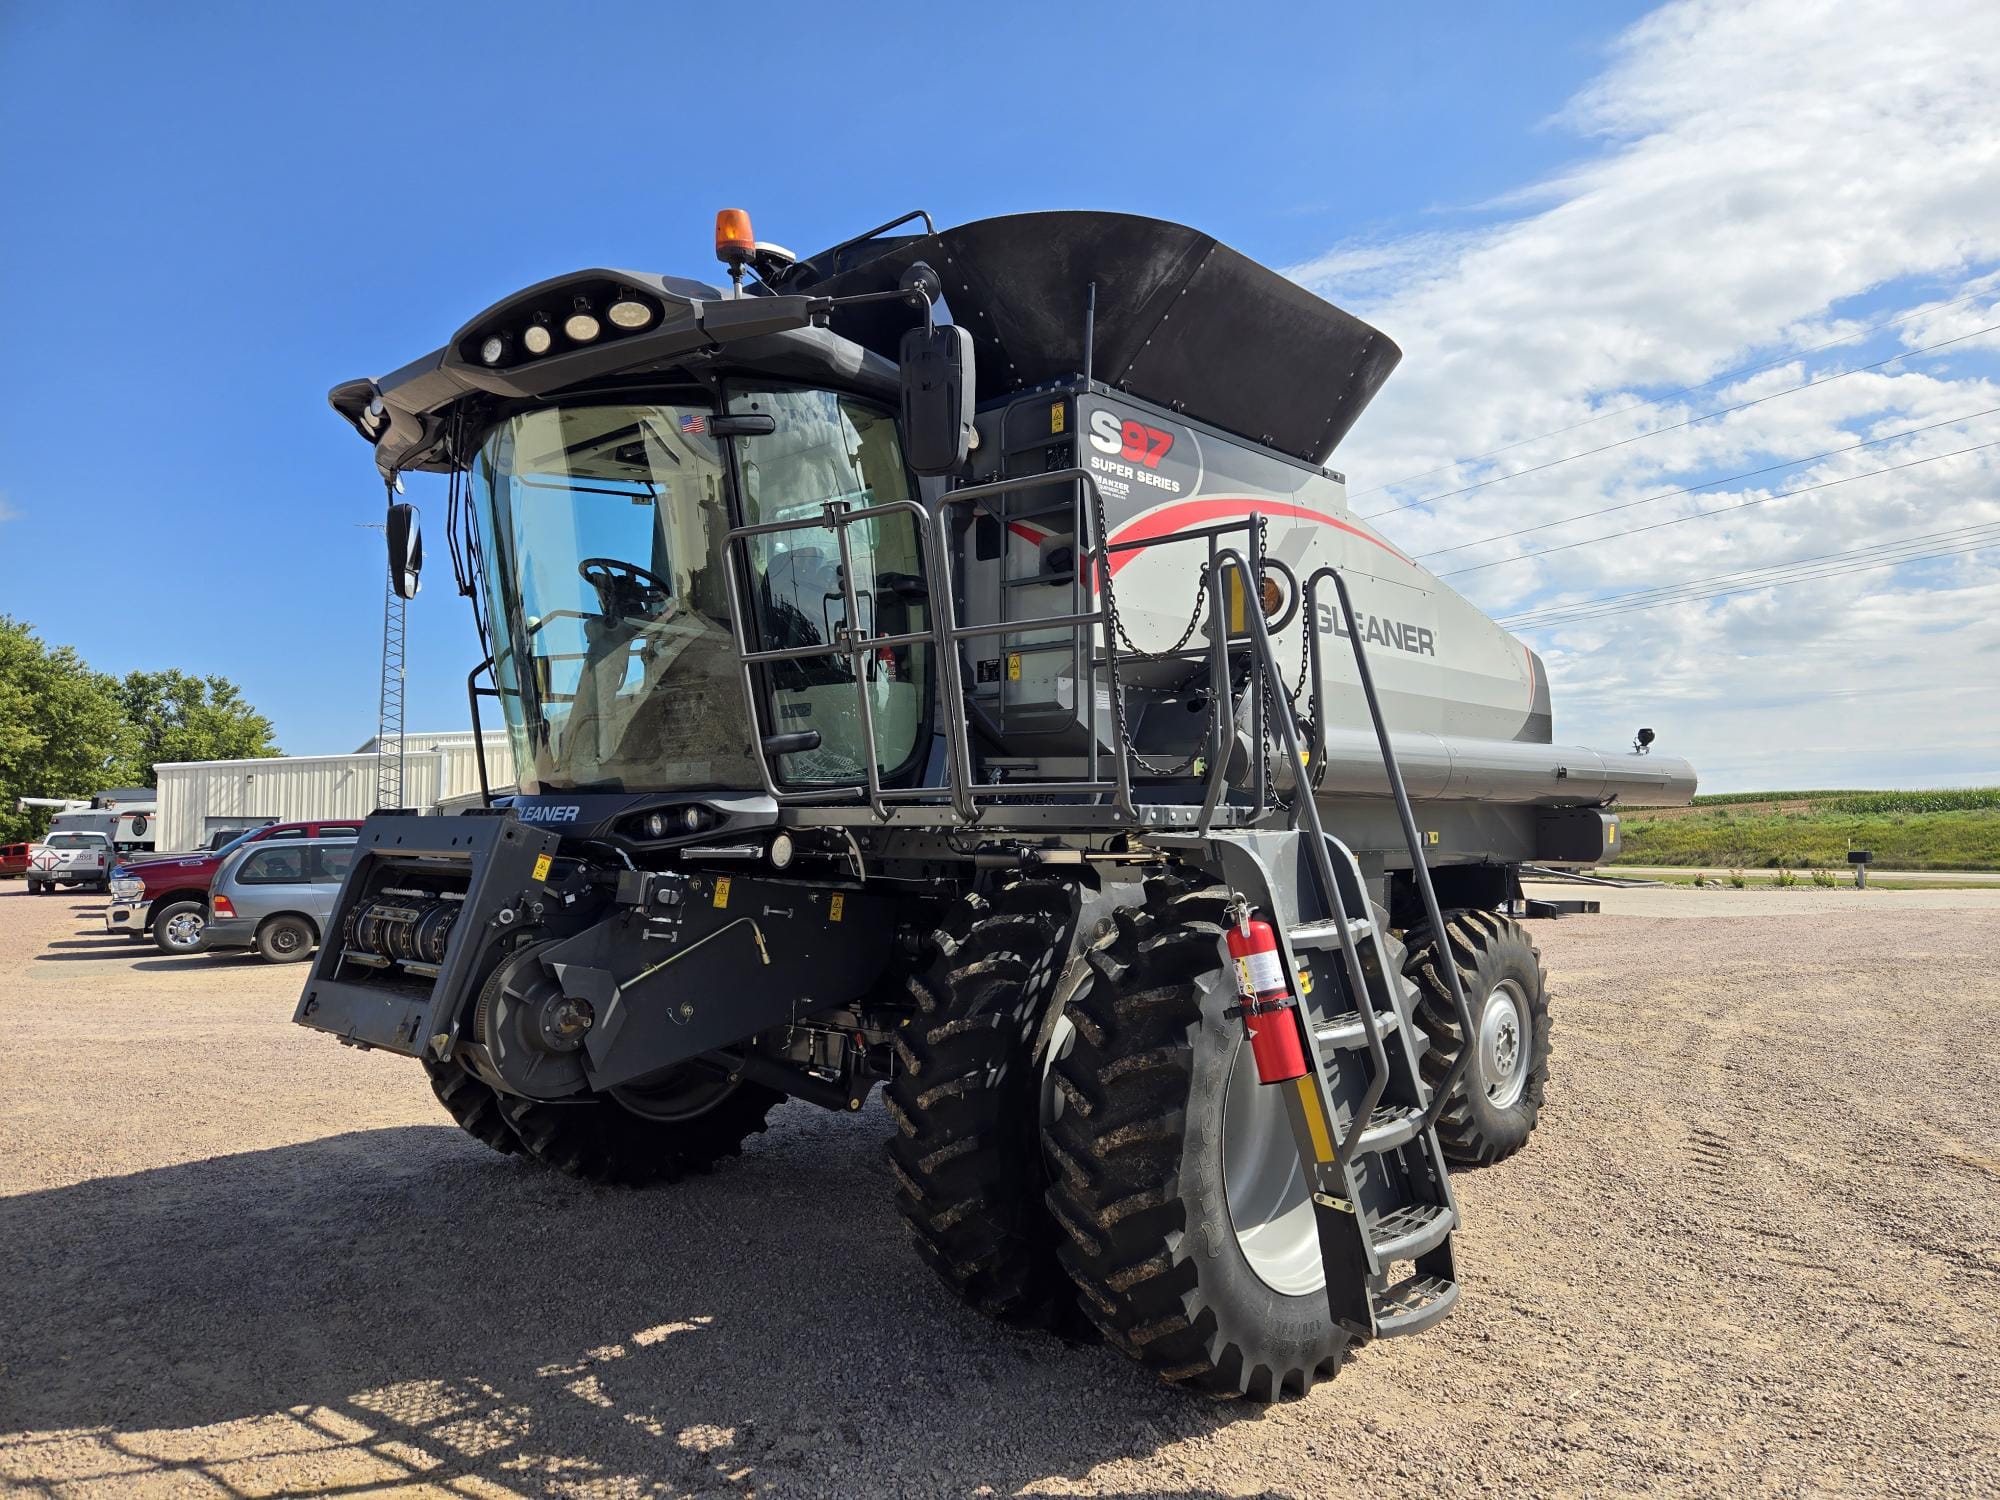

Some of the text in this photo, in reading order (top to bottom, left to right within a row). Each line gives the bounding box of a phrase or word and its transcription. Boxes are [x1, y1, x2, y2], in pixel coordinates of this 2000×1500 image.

[1089, 410, 1174, 469] S97
[1090, 456, 1134, 480] SUPER
[1136, 470, 1181, 493] SERIES
[517, 805, 580, 822] LEANER
